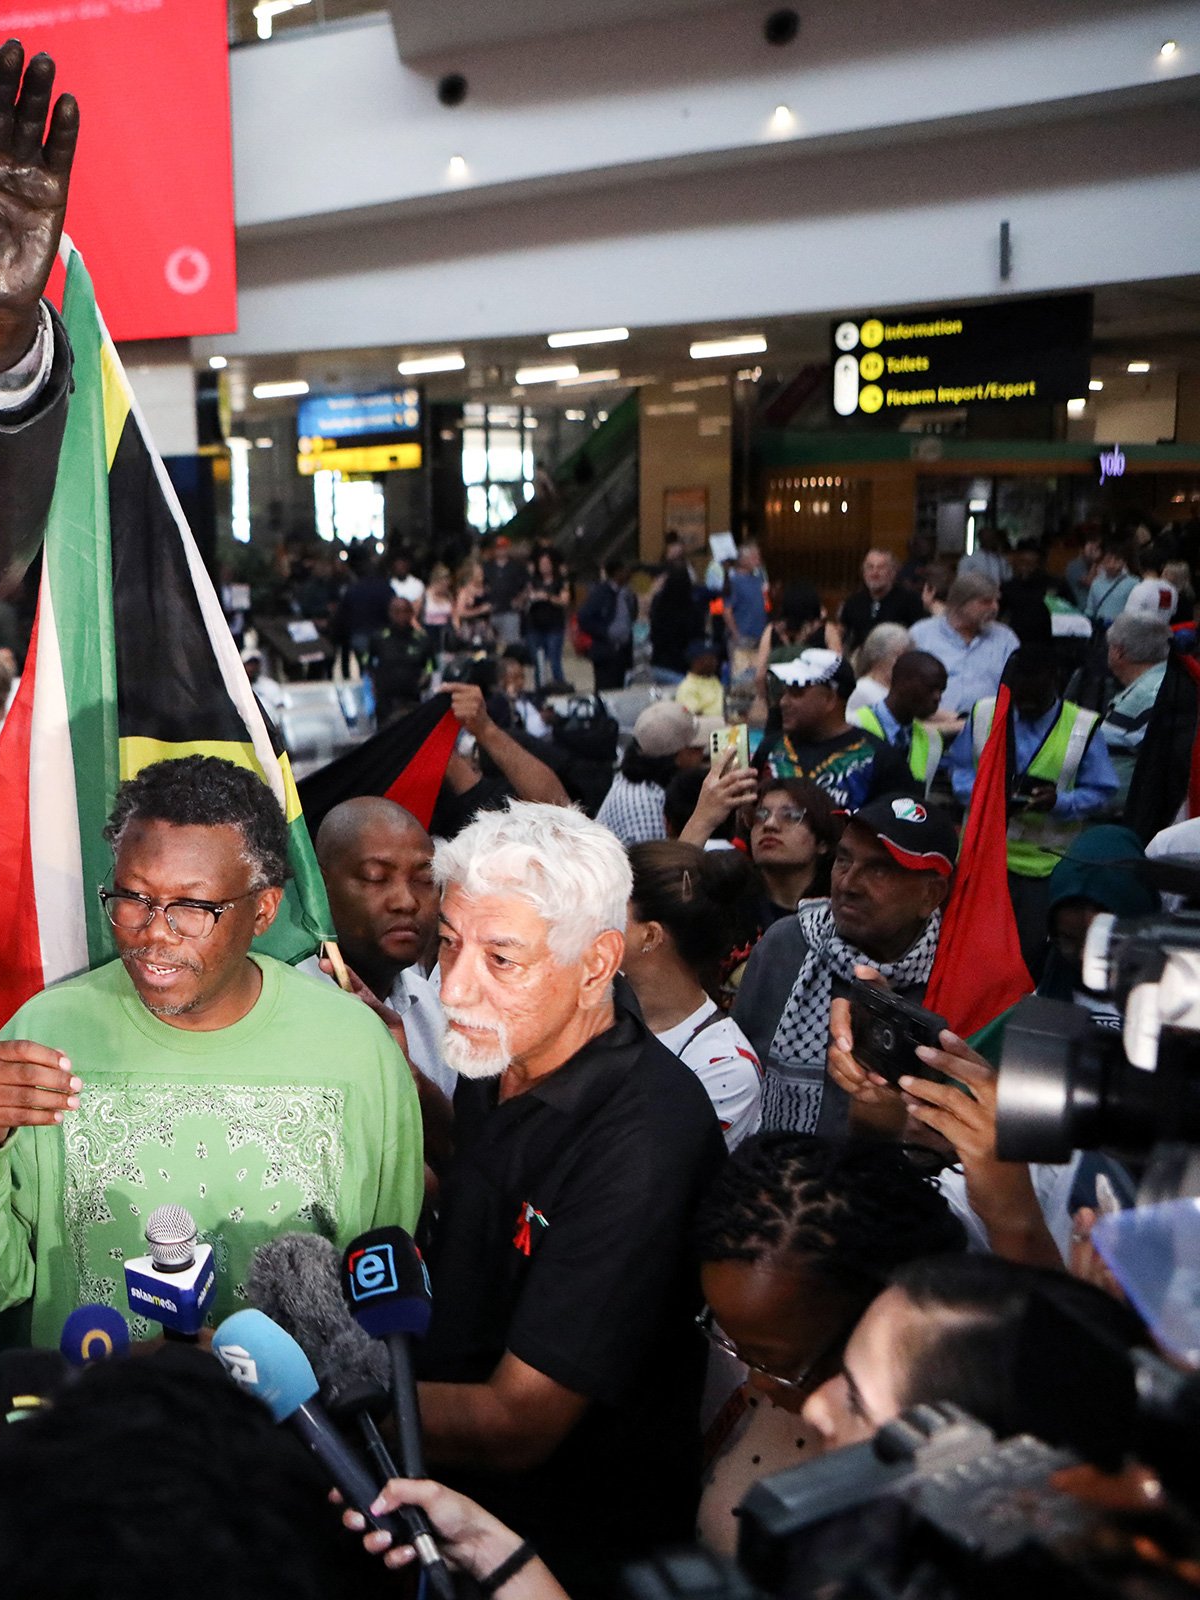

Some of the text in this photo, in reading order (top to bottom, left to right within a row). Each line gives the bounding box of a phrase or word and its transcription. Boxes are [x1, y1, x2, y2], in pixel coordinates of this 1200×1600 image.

[885, 319, 963, 341] Information
[887, 355, 930, 374] Toilets
[887, 380, 1036, 407] Firearm Import/Export
[1099, 443, 1126, 486] yolo
